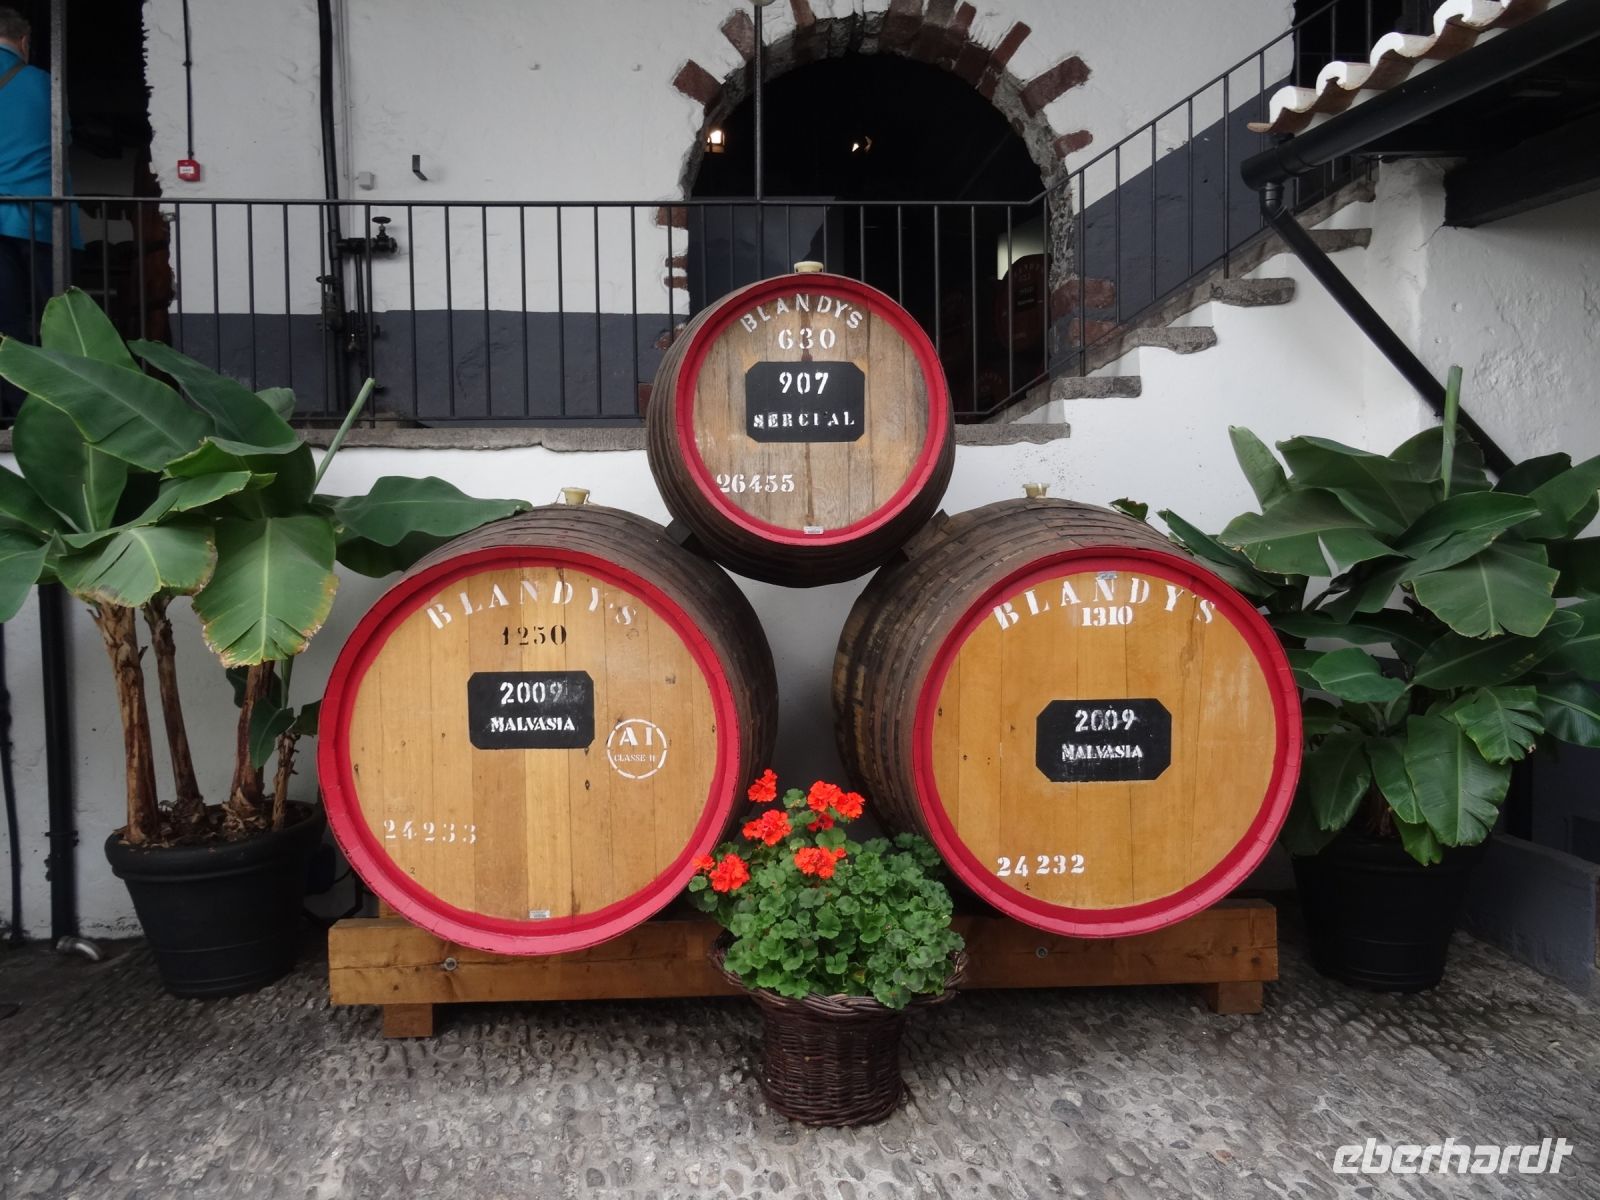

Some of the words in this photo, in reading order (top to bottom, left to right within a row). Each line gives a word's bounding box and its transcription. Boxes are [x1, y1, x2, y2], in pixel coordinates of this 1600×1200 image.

[740, 293, 863, 332] BLANDY'S
[778, 328, 836, 350] 630
[779, 371, 829, 394] 907
[753, 411, 855, 429] SERCIAL
[716, 473, 795, 493] 26455
[426, 580, 638, 630] BLANDY'S
[993, 576, 1215, 630] BLANDY'S
[1081, 605, 1133, 627] 1310
[502, 624, 567, 646] 1250
[500, 681, 563, 705] 2009
[490, 716, 575, 732] MALVASIA
[1075, 708, 1136, 732] 2009
[1061, 743, 1144, 761] MALVASIA
[383, 819, 476, 845] 24233
